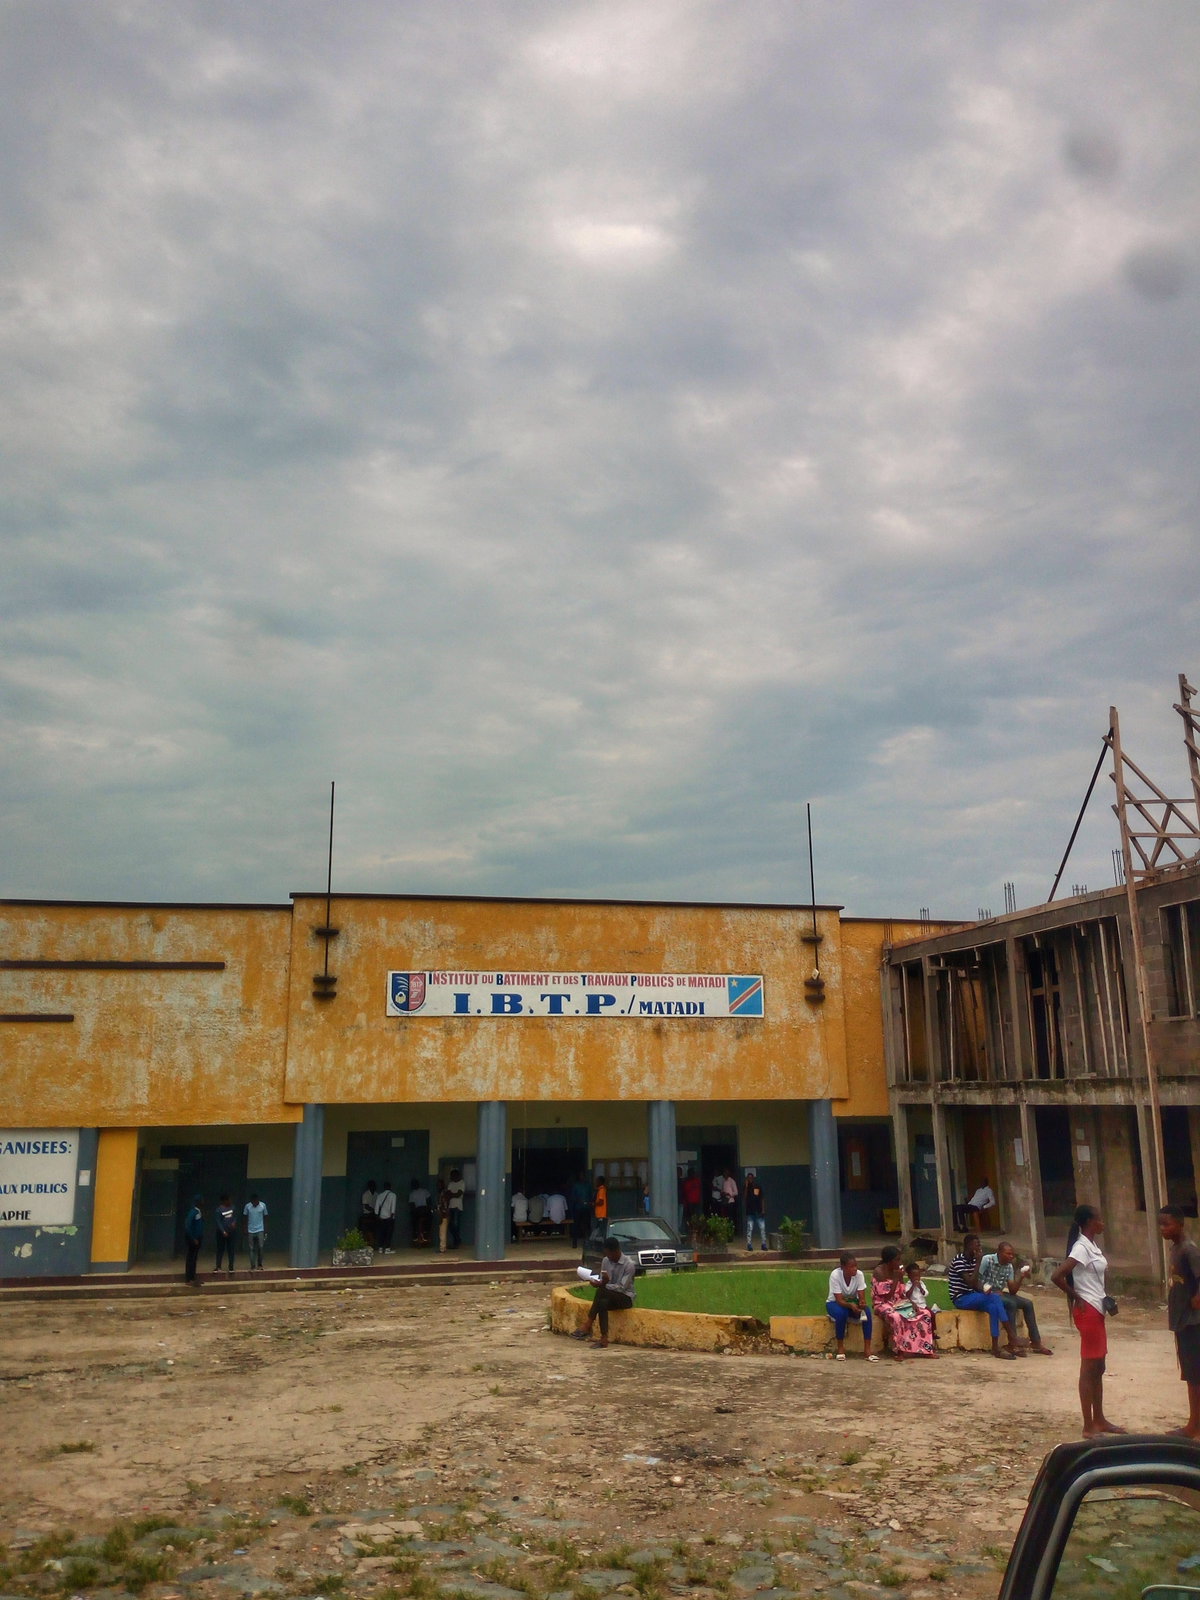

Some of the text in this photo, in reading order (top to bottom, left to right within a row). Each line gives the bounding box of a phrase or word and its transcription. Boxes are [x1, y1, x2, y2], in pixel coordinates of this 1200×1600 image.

[429, 973, 726, 988] INSTITUT DU BATIMENT ET DES TRAVAUX PUBLICS DE MATADI
[0, 1141, 72, 1154] ANISEES:
[20, 1183, 68, 1194] PUBLICS
